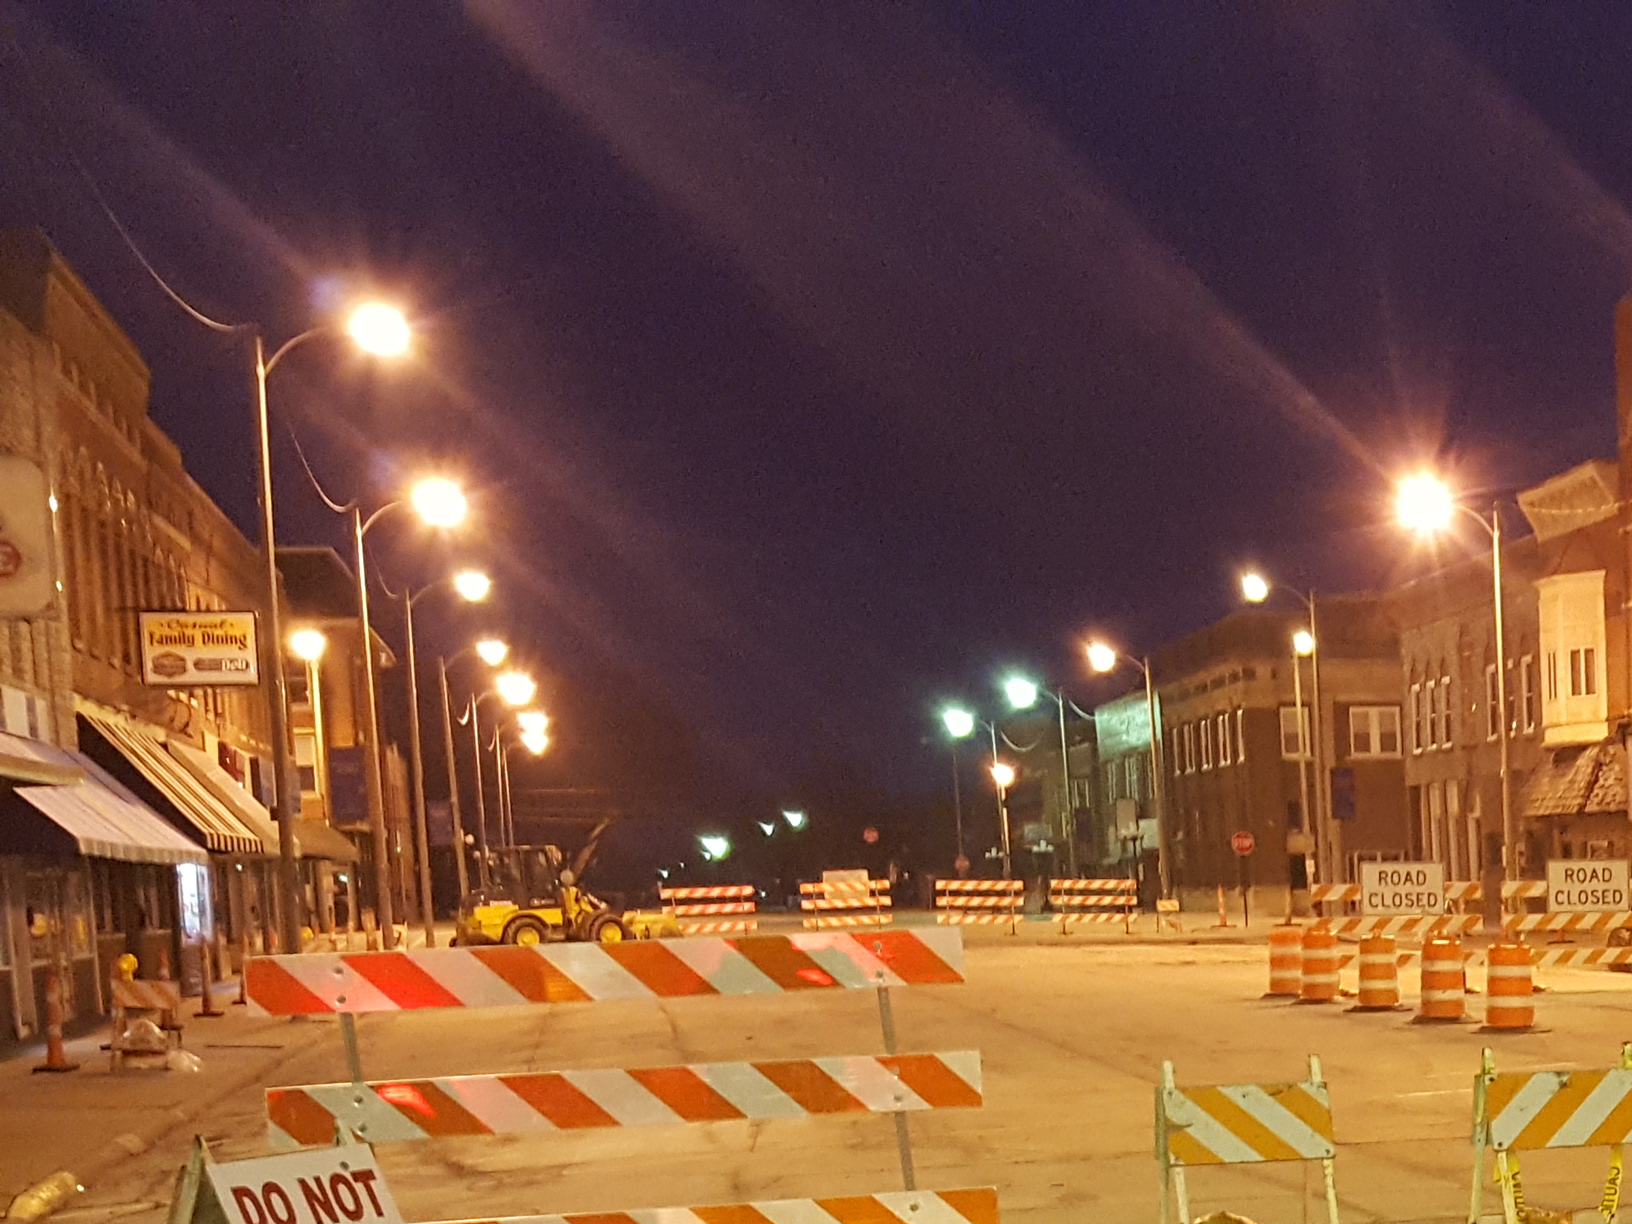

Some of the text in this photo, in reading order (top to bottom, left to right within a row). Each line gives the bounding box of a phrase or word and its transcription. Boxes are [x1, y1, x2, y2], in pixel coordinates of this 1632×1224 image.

[149, 631, 248, 650] Family Dining
[1378, 870, 1427, 886] ROAD
[1564, 867, 1613, 883] ROAD
[1368, 892, 1438, 908] CLOSED
[1555, 889, 1623, 905] CLOSED
